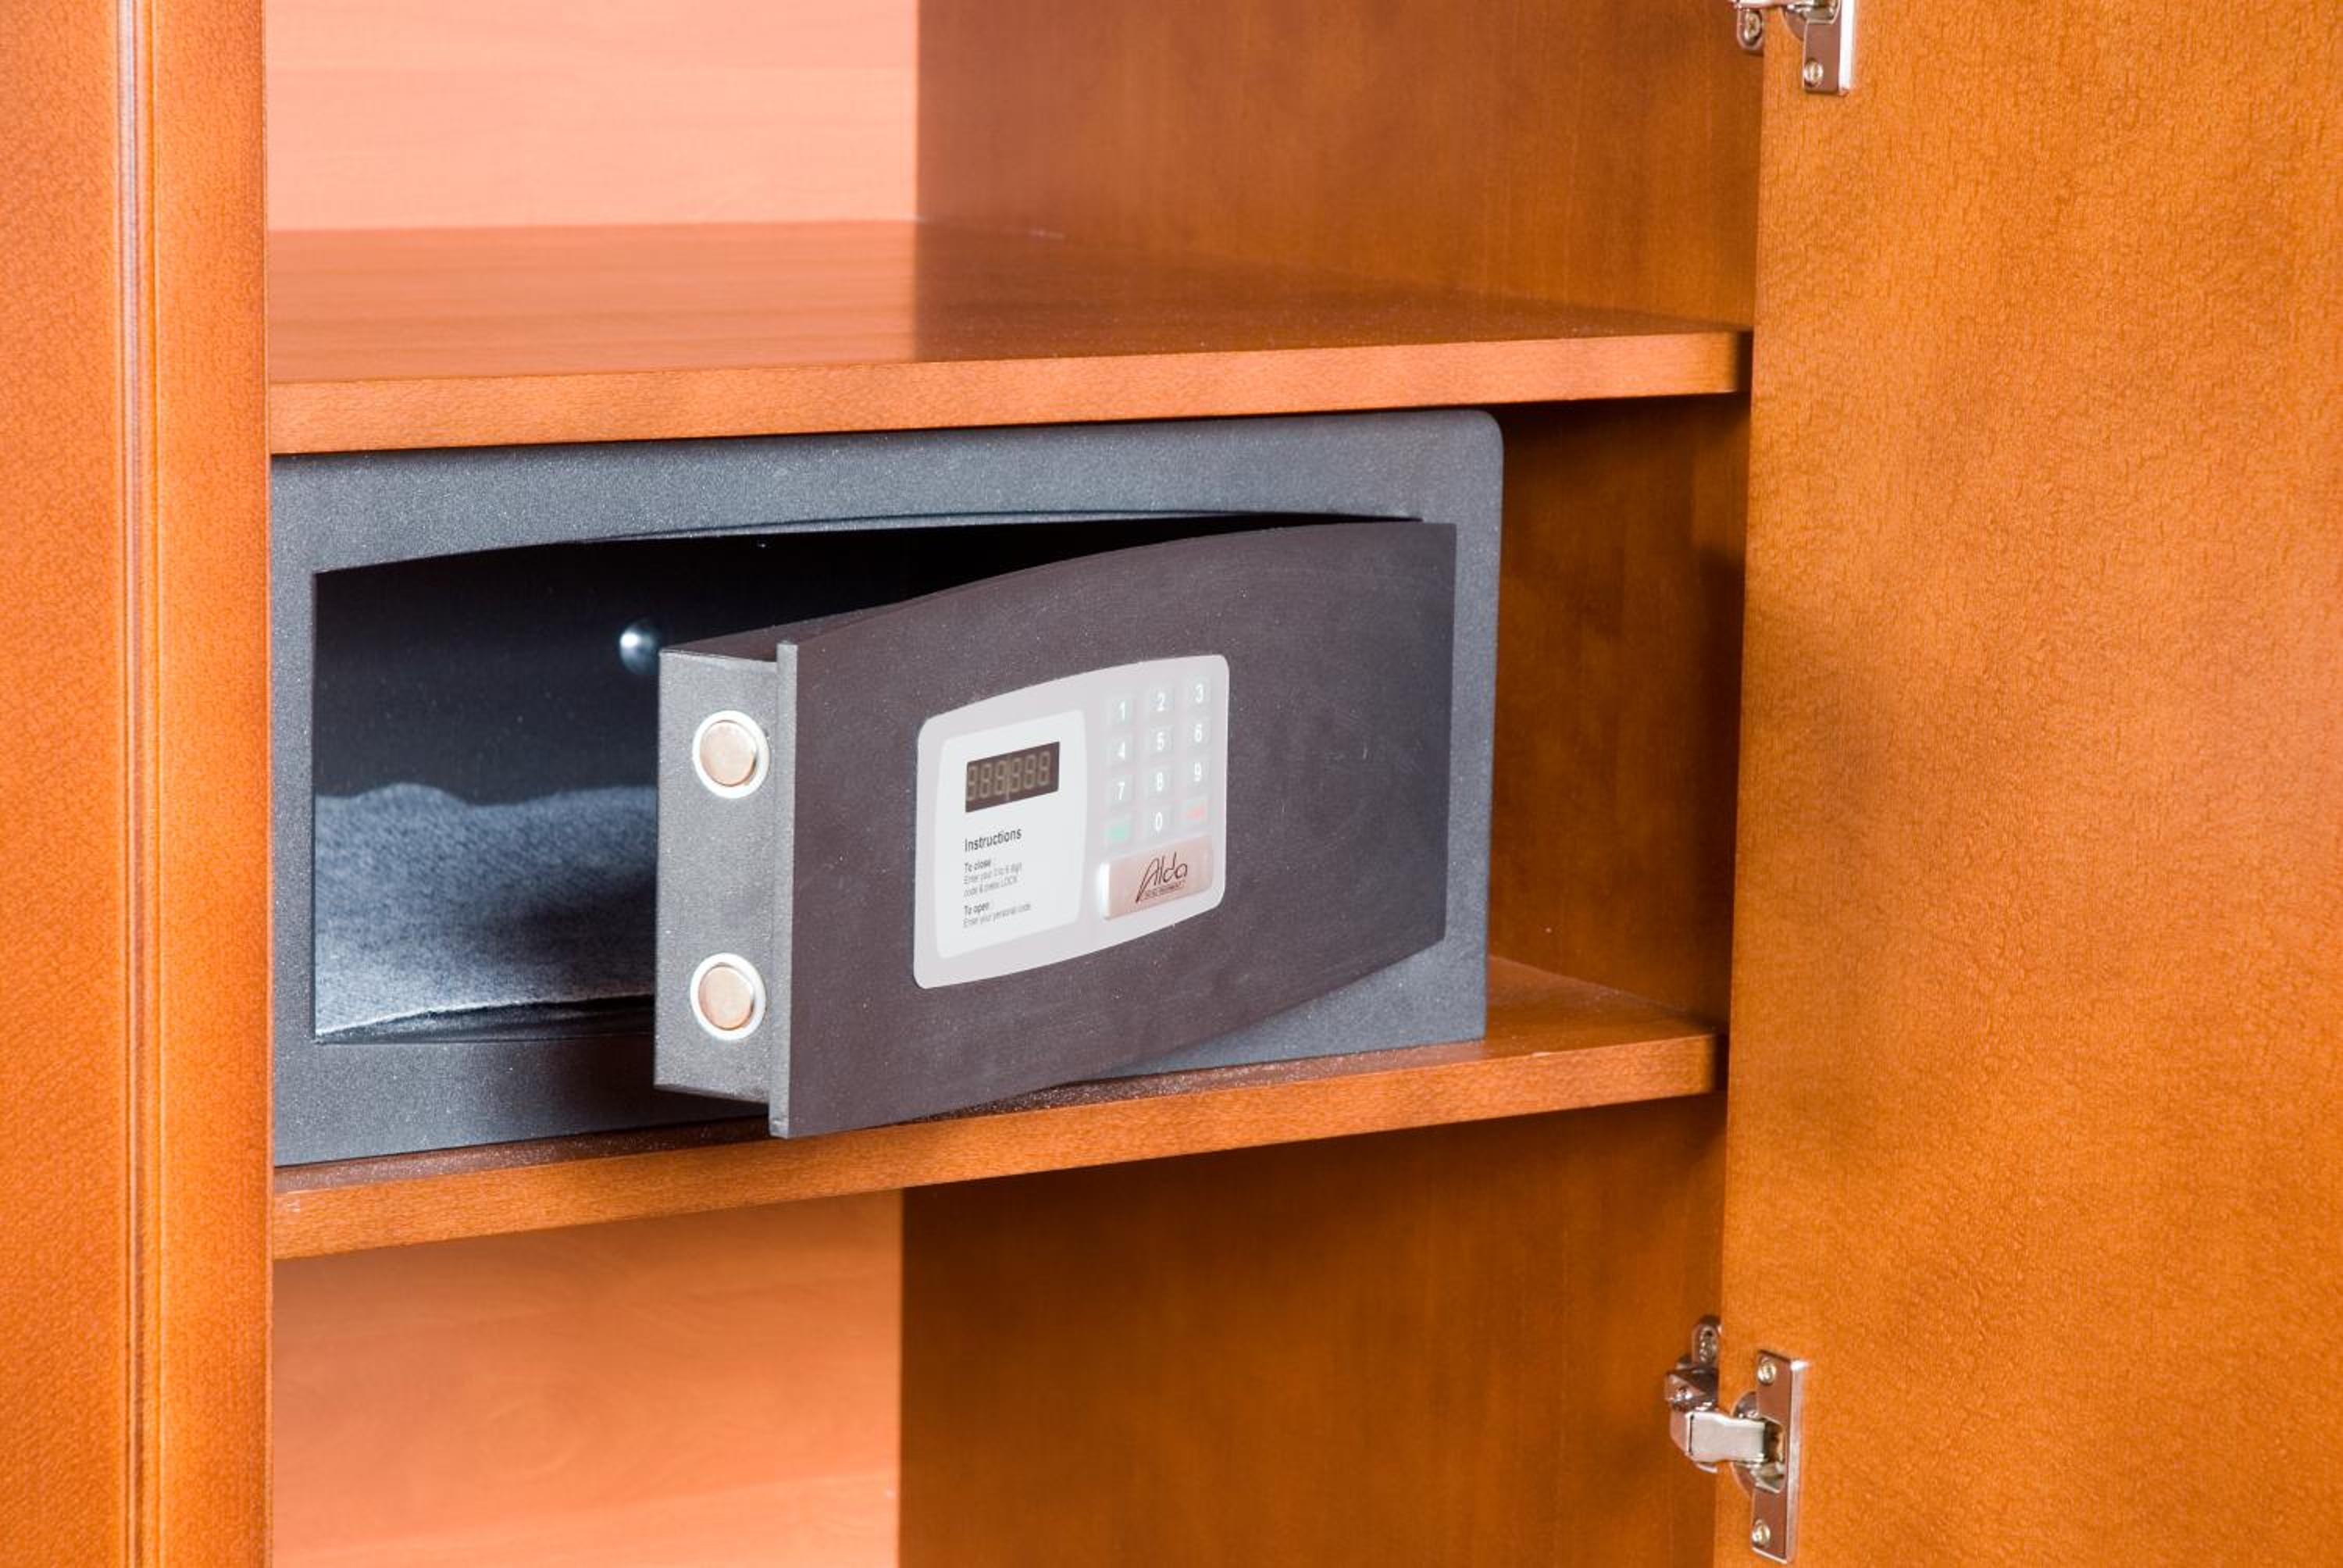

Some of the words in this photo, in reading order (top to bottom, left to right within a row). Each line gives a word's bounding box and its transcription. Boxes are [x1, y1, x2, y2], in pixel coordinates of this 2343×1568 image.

[1118, 701, 1125, 721] 1
[1157, 691, 1165, 712] 2
[1195, 683, 1204, 704] 3
[1118, 741, 1125, 760] 4
[1156, 731, 1164, 751] 5
[1194, 723, 1203, 743] 6
[1118, 781, 1125, 800] 7
[1156, 772, 1164, 792] 8
[1194, 761, 1202, 782] 9
[1155, 811, 1163, 832] 0
[965, 829, 1022, 852] Instructions
[964, 862, 972, 873] To
[964, 905, 972, 916] To
